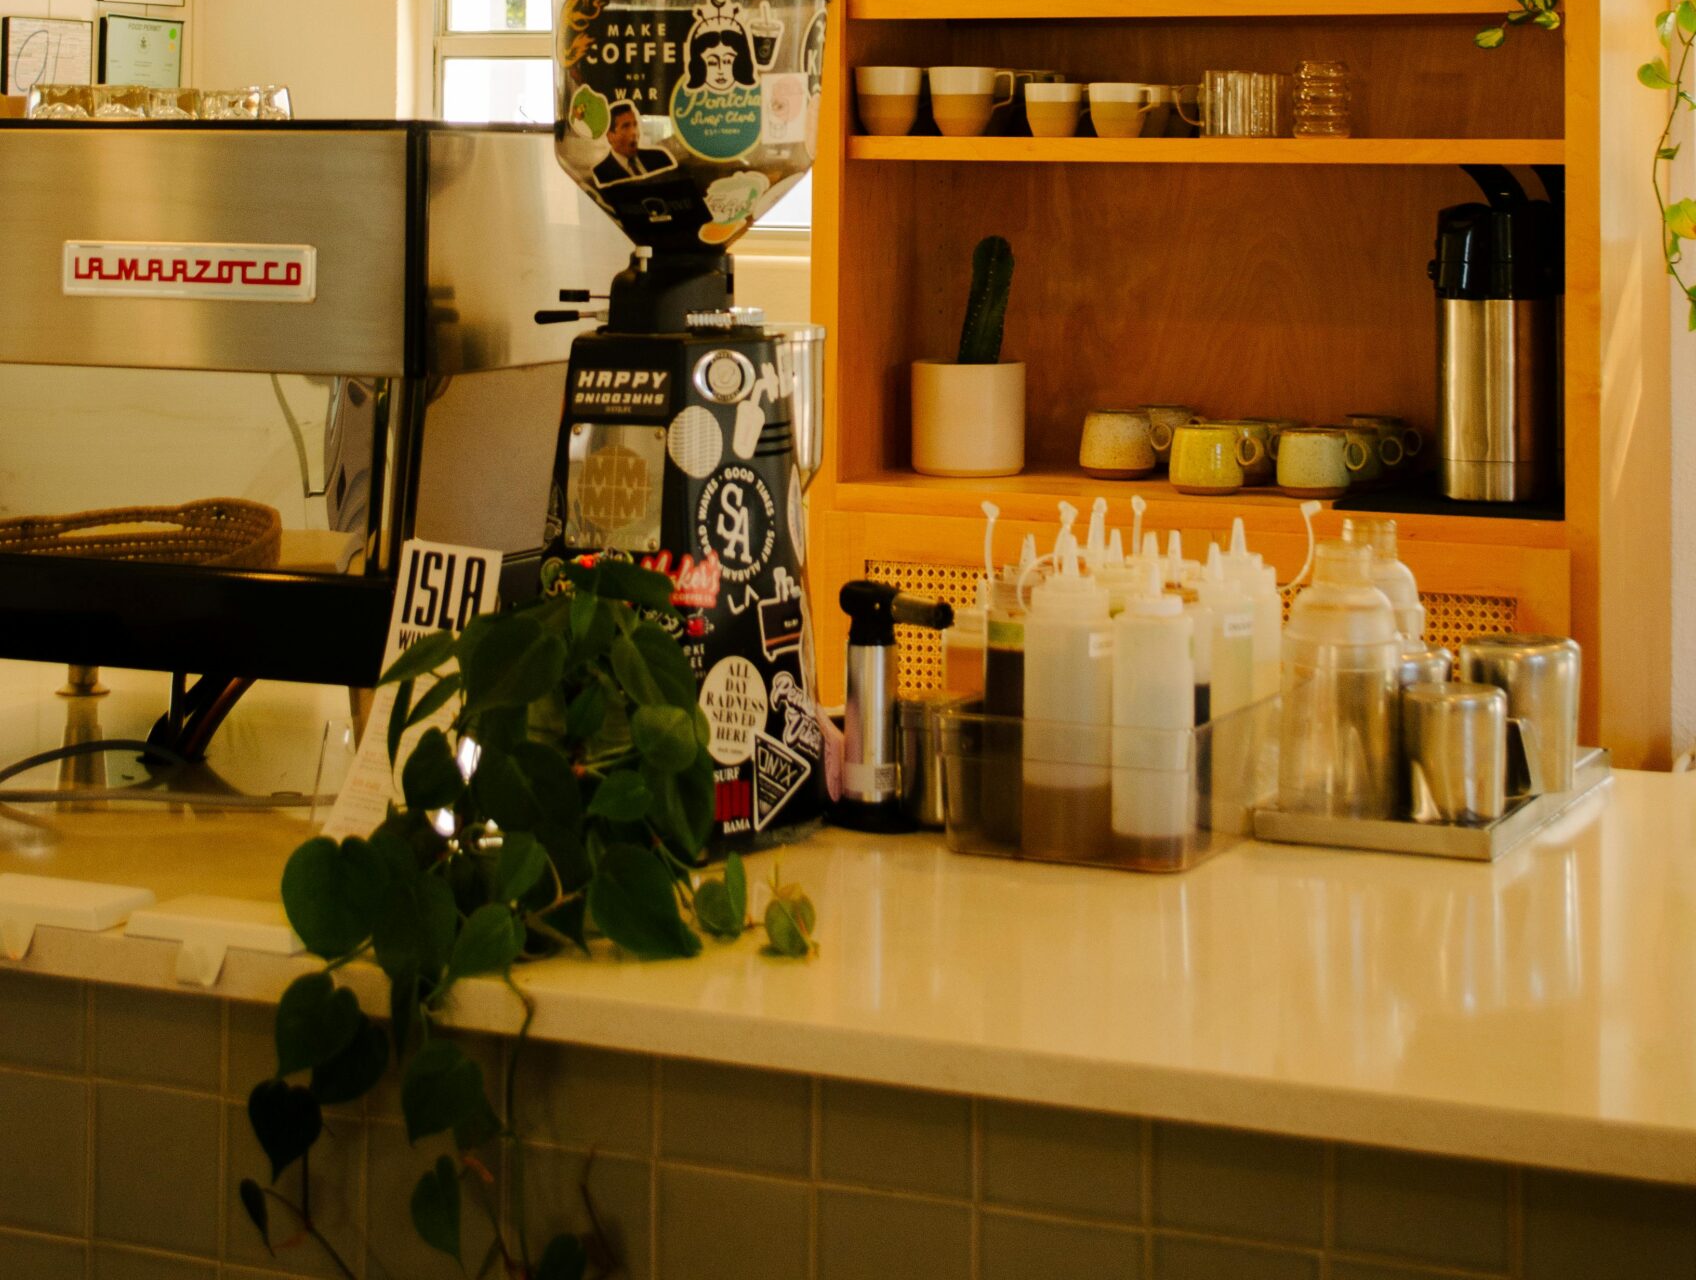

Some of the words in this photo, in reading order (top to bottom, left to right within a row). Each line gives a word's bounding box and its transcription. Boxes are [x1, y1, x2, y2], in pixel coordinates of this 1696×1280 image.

[607, 23, 667, 37] MAKE
[586, 42, 689, 64] COFFE
[615, 87, 658, 101] WAR
[75, 257, 103, 280] LA
[578, 370, 667, 389] HAPPY
[698, 478, 719, 520] WAVES
[724, 466, 754, 483] GOOD
[756, 480, 775, 517] TIMES
[401, 549, 487, 632] ISLA
[725, 678, 747, 694] DAY
[712, 710, 756, 727] SERVED
[716, 727, 747, 743] HERE
[713, 766, 740, 782] SURF
[758, 746, 798, 787] ONYX
